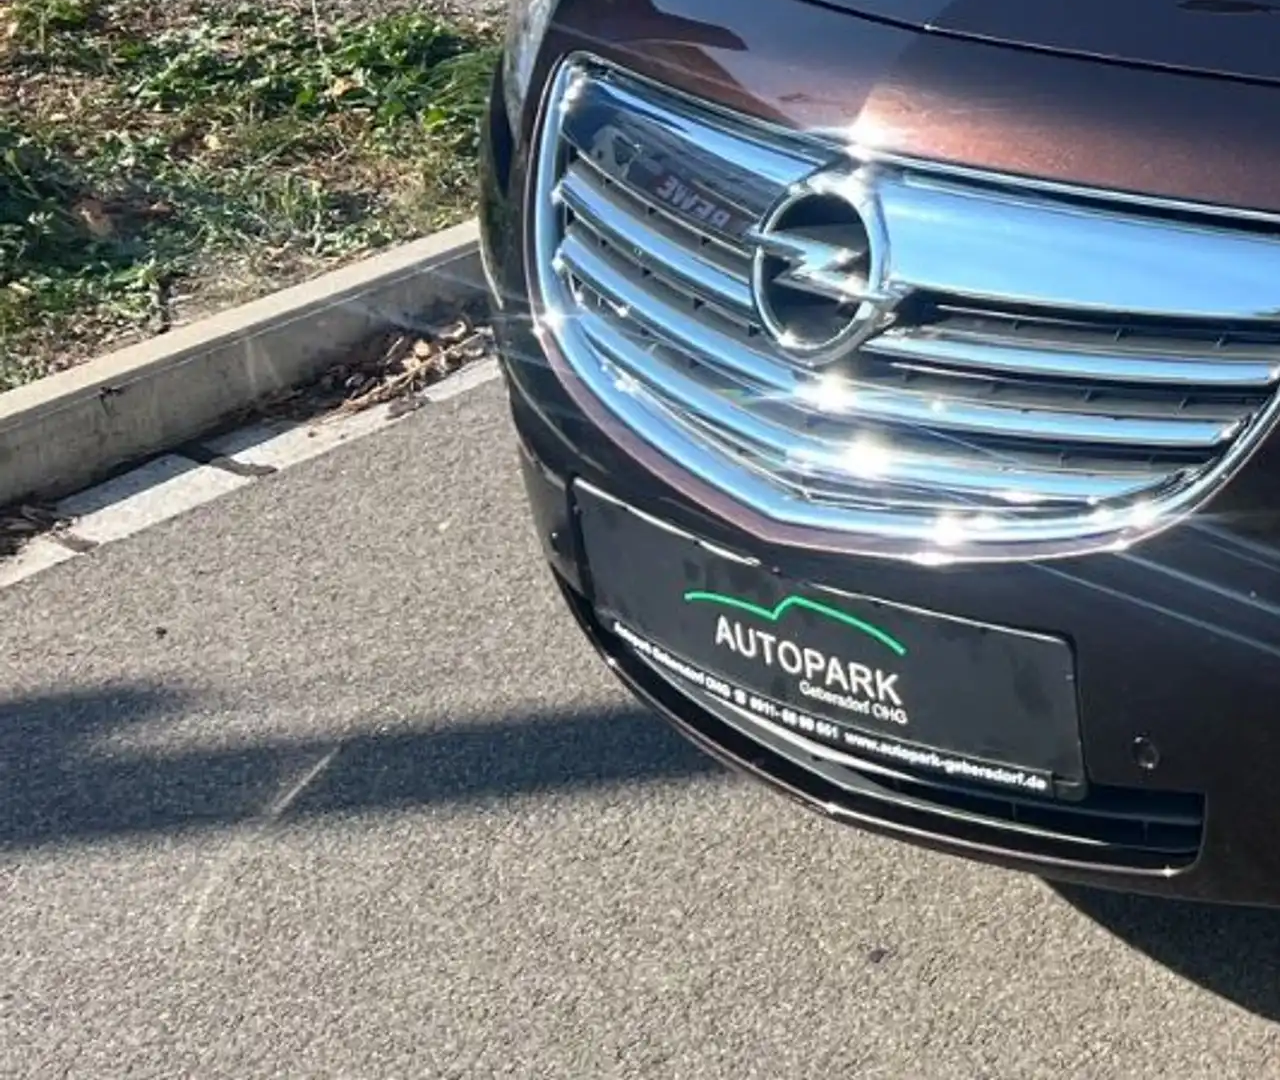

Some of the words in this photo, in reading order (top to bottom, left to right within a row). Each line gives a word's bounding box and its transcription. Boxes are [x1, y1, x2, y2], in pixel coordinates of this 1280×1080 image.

[715, 614, 903, 706] AUTOPARK
[799, 679, 870, 716] Gebersdorf
[871, 701, 908, 726] OHG
